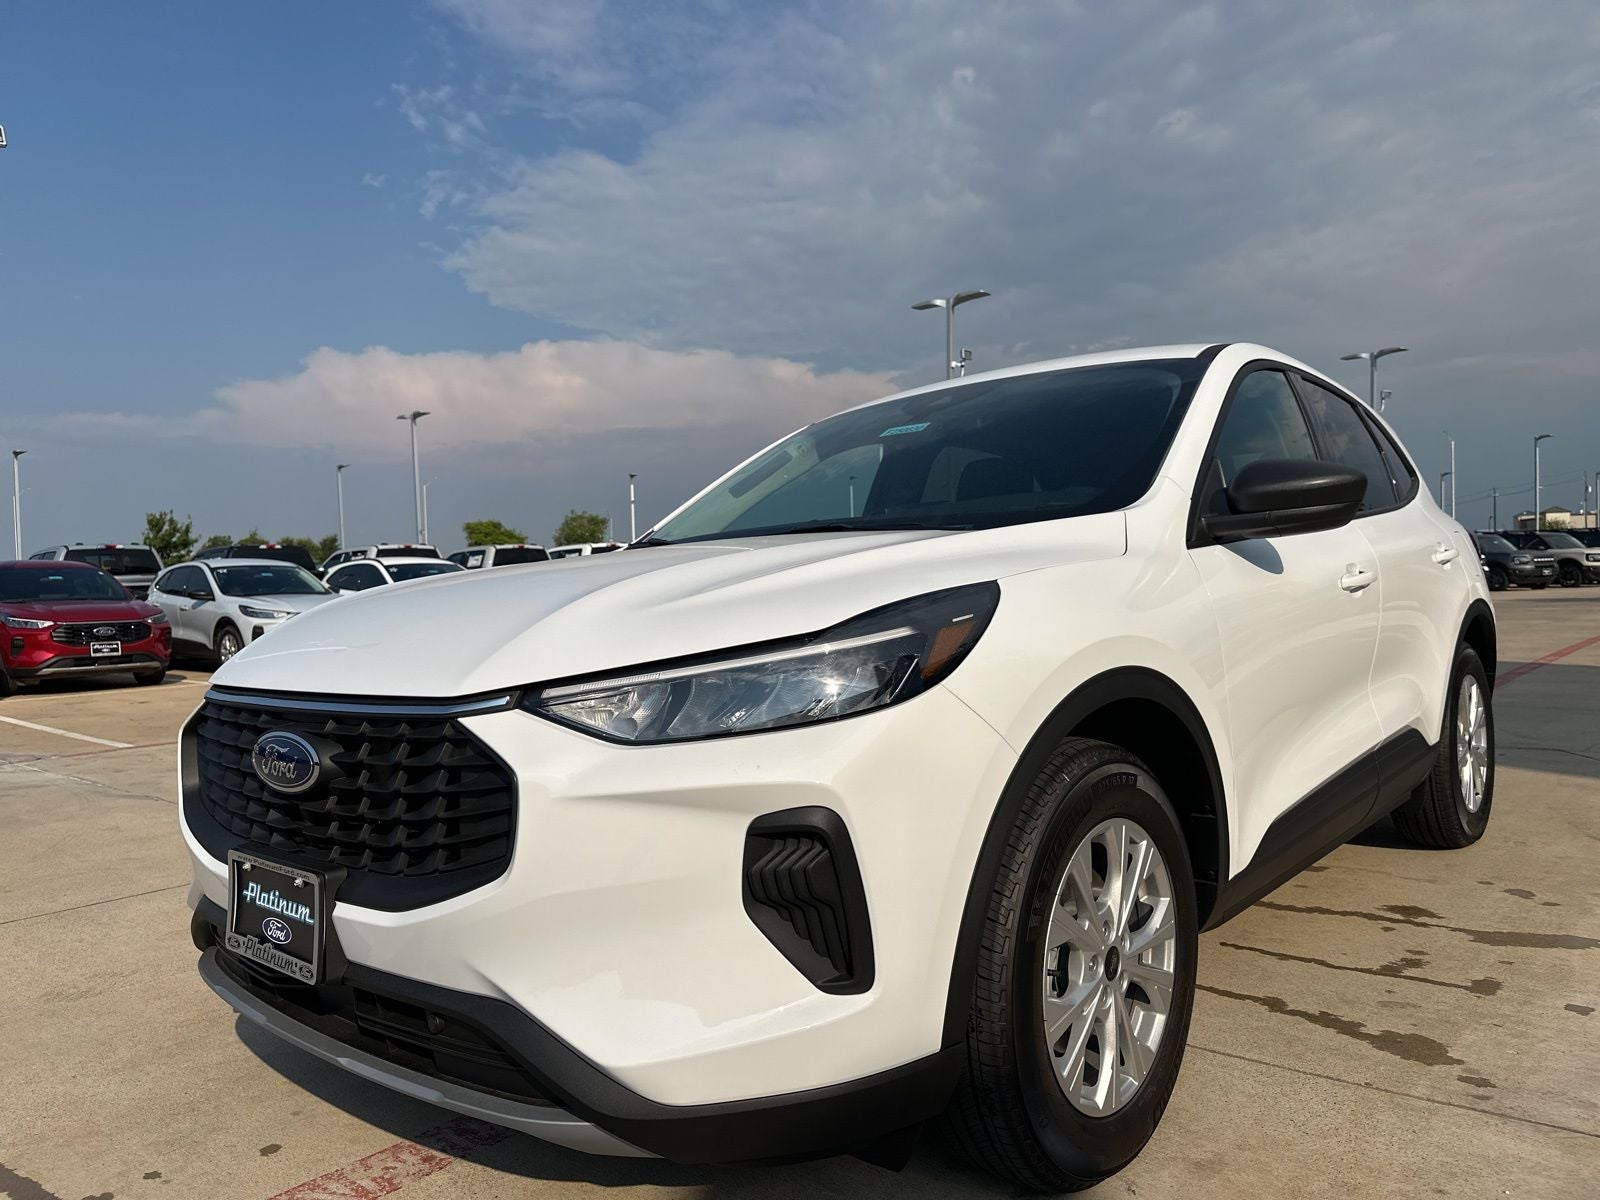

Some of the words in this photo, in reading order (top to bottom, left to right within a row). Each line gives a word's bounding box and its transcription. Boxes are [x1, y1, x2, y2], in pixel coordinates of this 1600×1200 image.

[261, 743, 298, 779] Ford
[242, 881, 315, 924] Platinum
[267, 919, 288, 941] Ford
[245, 937, 297, 975] Platinum
